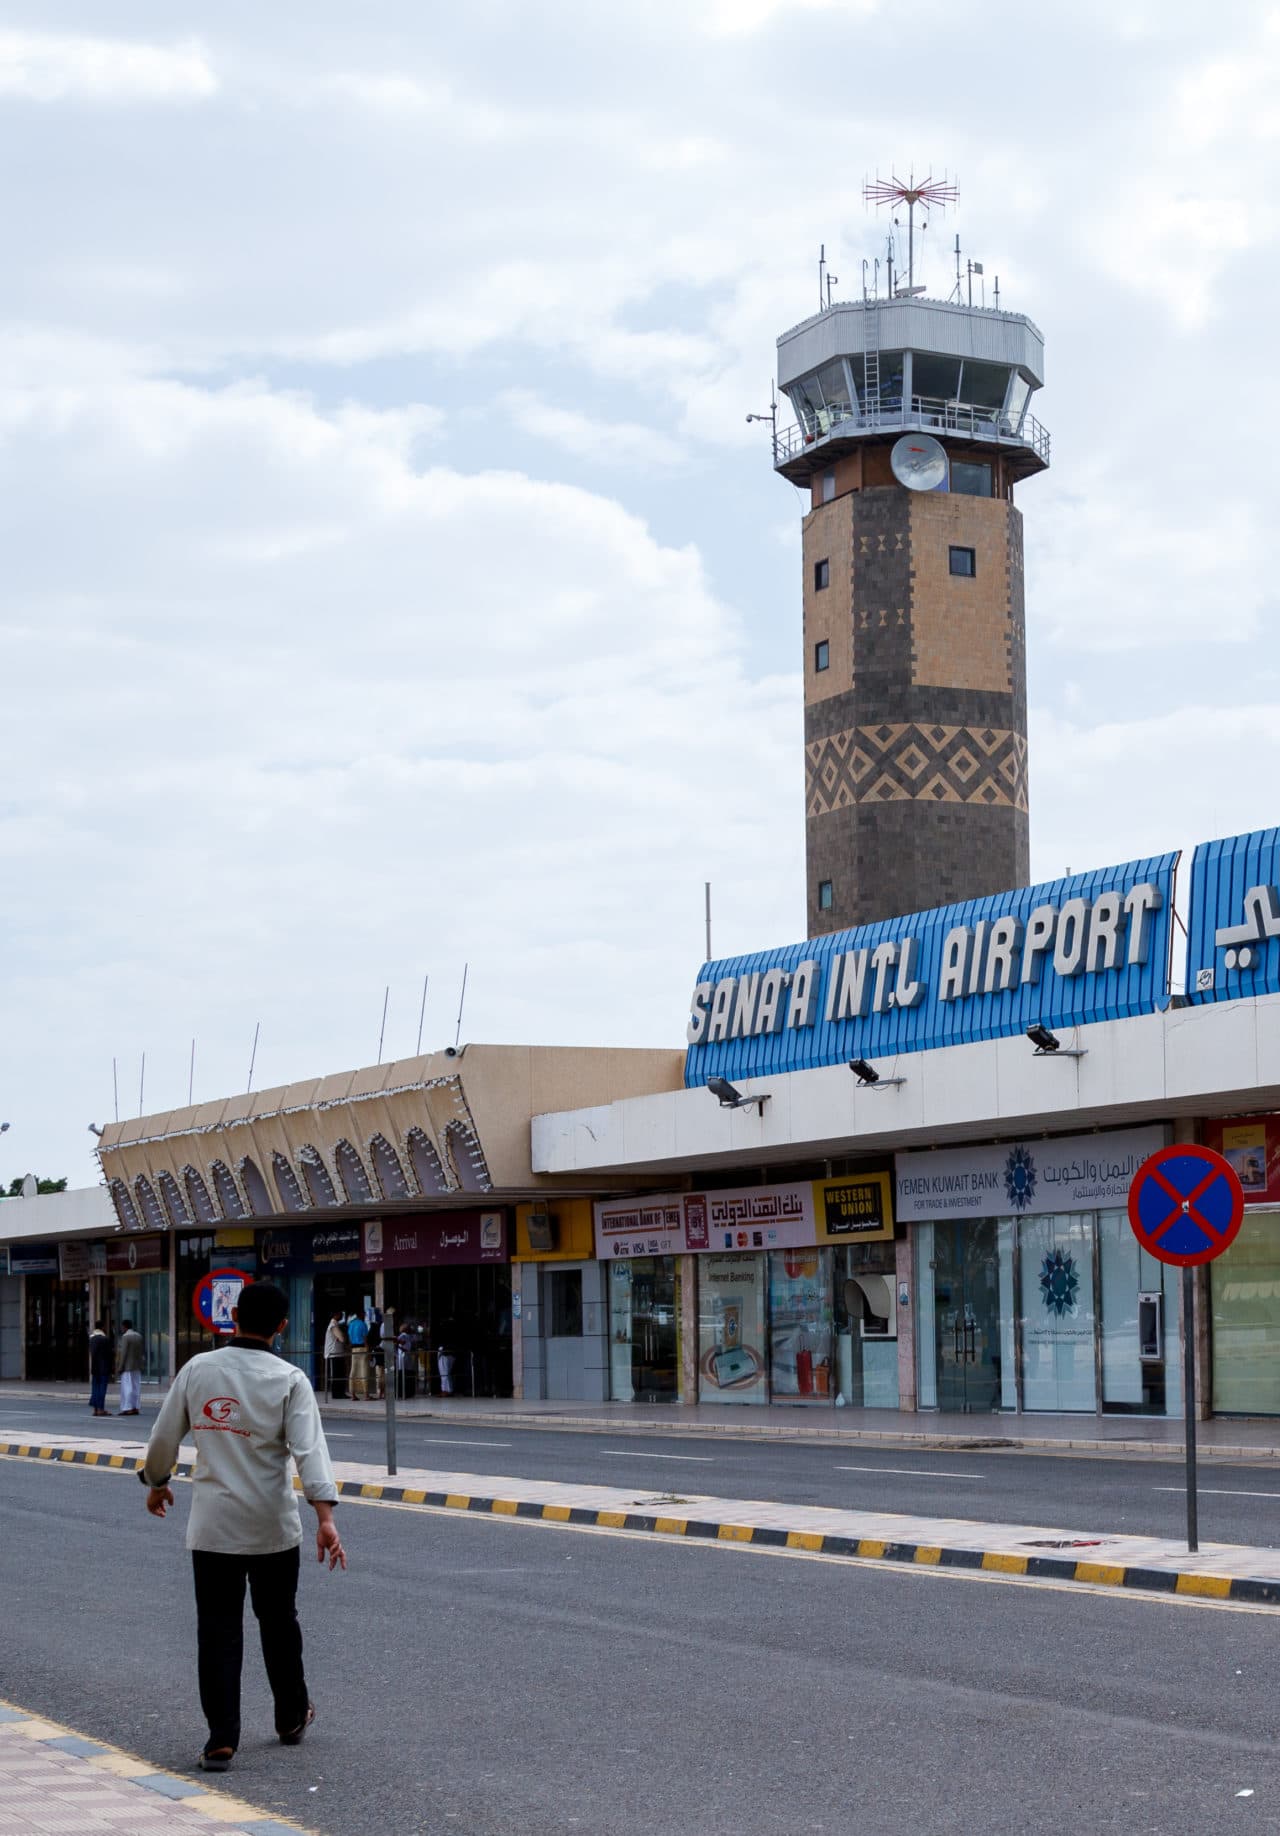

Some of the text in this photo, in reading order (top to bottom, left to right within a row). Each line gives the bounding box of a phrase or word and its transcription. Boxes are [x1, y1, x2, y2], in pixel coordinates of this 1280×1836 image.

[687, 959, 821, 1046] SANA'A
[939, 882, 1163, 1002] AIRPORT
[1043, 1159, 1097, 1186] والكويت
[1099, 1154, 1134, 1182] اليمن
[899, 1171, 1000, 1195] YEMEN KUWAIT BANK
[712, 1194, 804, 1228] بنك اليمن الدولي
[826, 1187, 873, 1217] WESTERN UNION
[914, 1200, 925, 1210] FOR
[926, 1199, 942, 1209] TRADE
[949, 1196, 982, 1208] INVESTMENT
[393, 1231, 418, 1251] Arrival
[440, 1229, 469, 1248] الوصول
[632, 1242, 646, 1254] VISA
